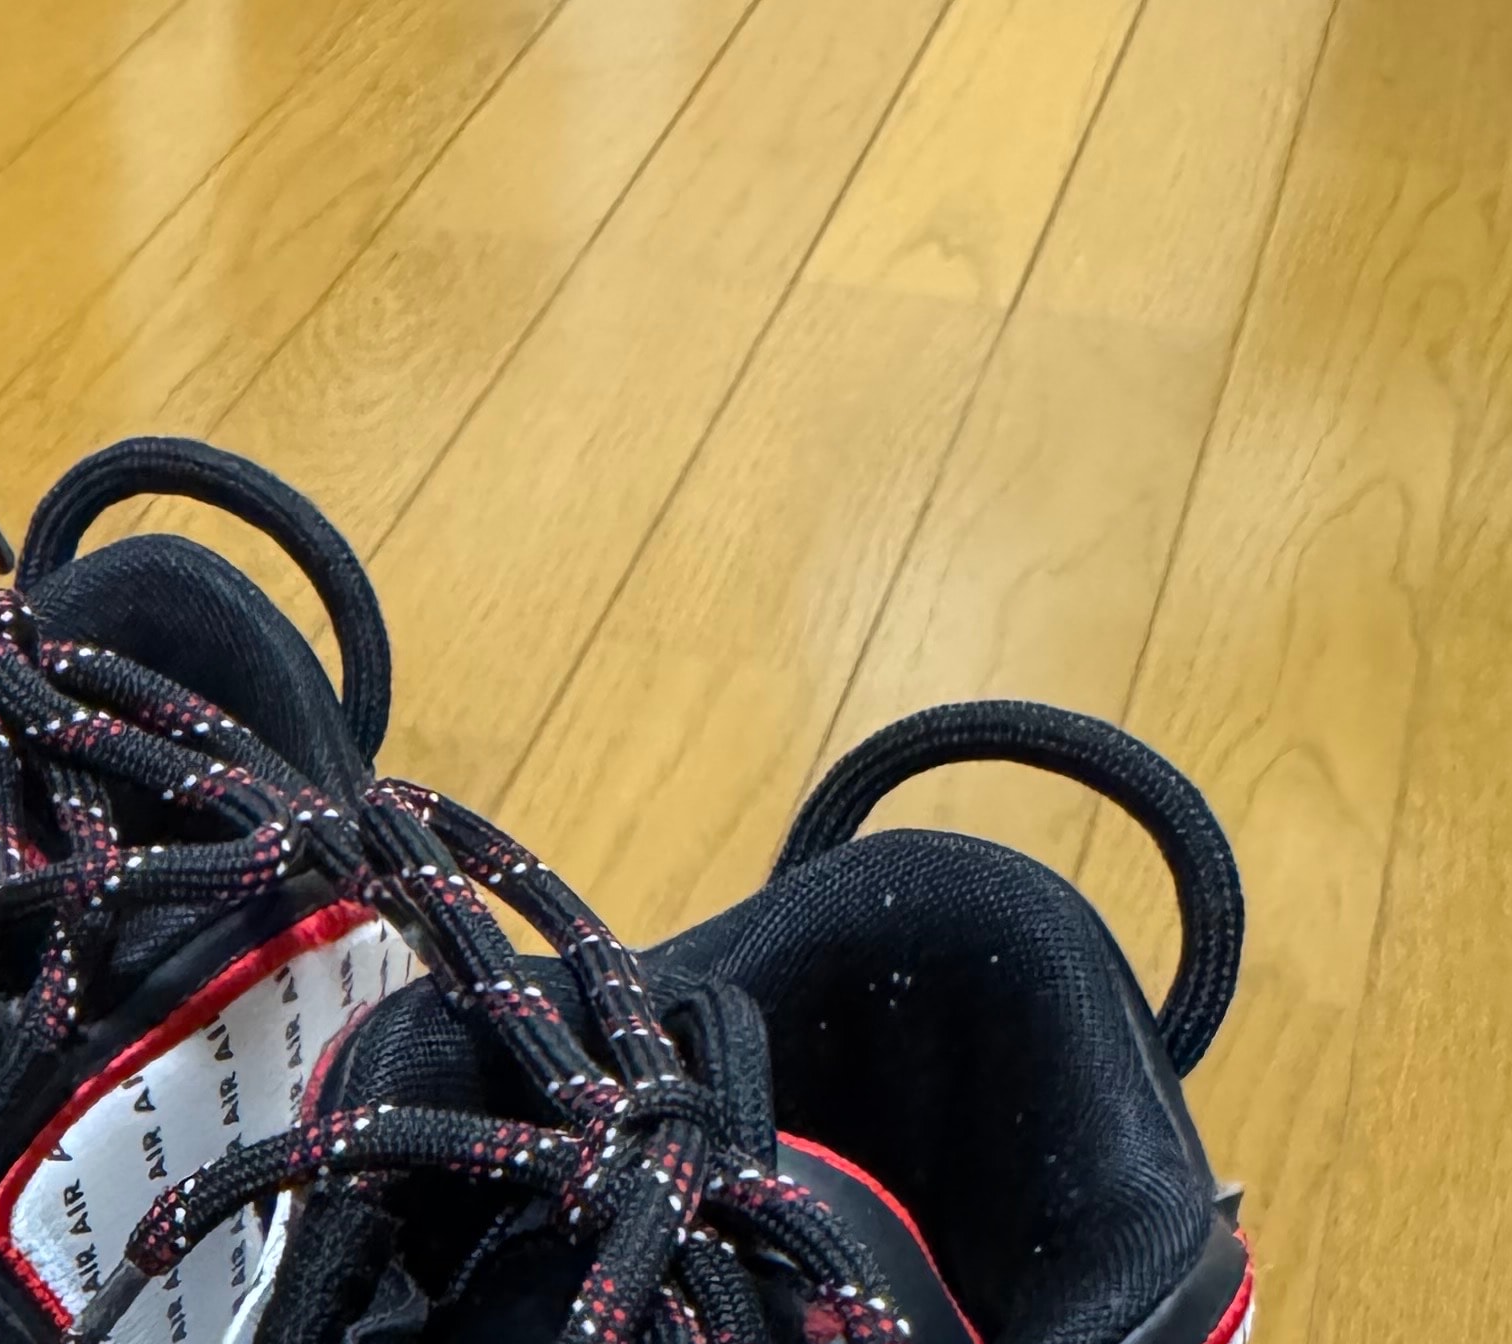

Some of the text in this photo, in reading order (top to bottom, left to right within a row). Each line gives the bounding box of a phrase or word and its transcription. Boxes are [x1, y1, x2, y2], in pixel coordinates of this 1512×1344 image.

[274, 965, 299, 1004] AI
[206, 1023, 235, 1062] AI
[285, 1013, 303, 1069] AIR
[219, 1070, 240, 1126] AIR
[121, 1075, 168, 1181] AIR AI
[63, 1178, 93, 1236] AIR
[166, 1295, 188, 1344] AIR
